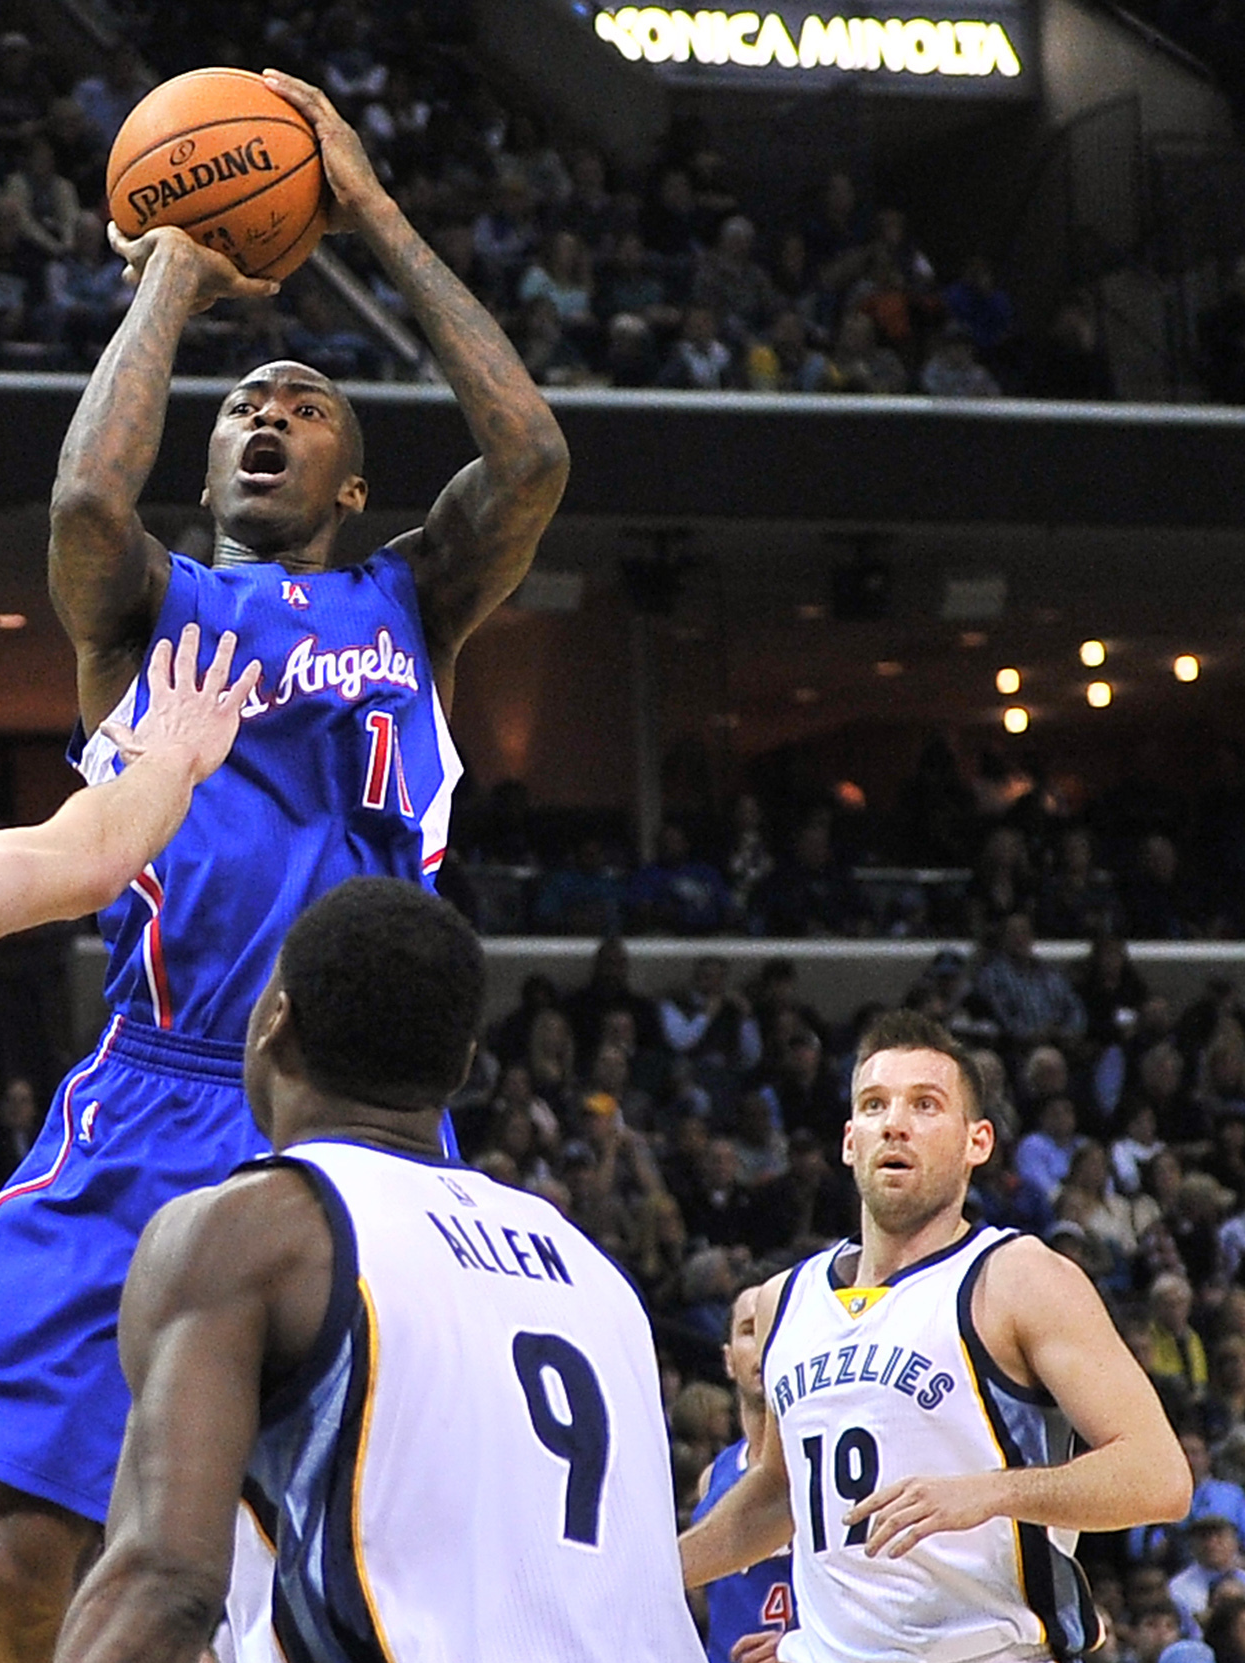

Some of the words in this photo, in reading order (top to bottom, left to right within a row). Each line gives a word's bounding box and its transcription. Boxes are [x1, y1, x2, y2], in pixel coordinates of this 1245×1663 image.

[799, 15, 1021, 76] MINOLTA
[128, 136, 273, 226] SPALDING
[275, 629, 419, 706] Angeles
[425, 1210, 574, 1286] ALLEN
[772, 1343, 955, 1411] RIZZLIES
[512, 1330, 611, 1547] 9
[802, 1426, 880, 1553] 19
